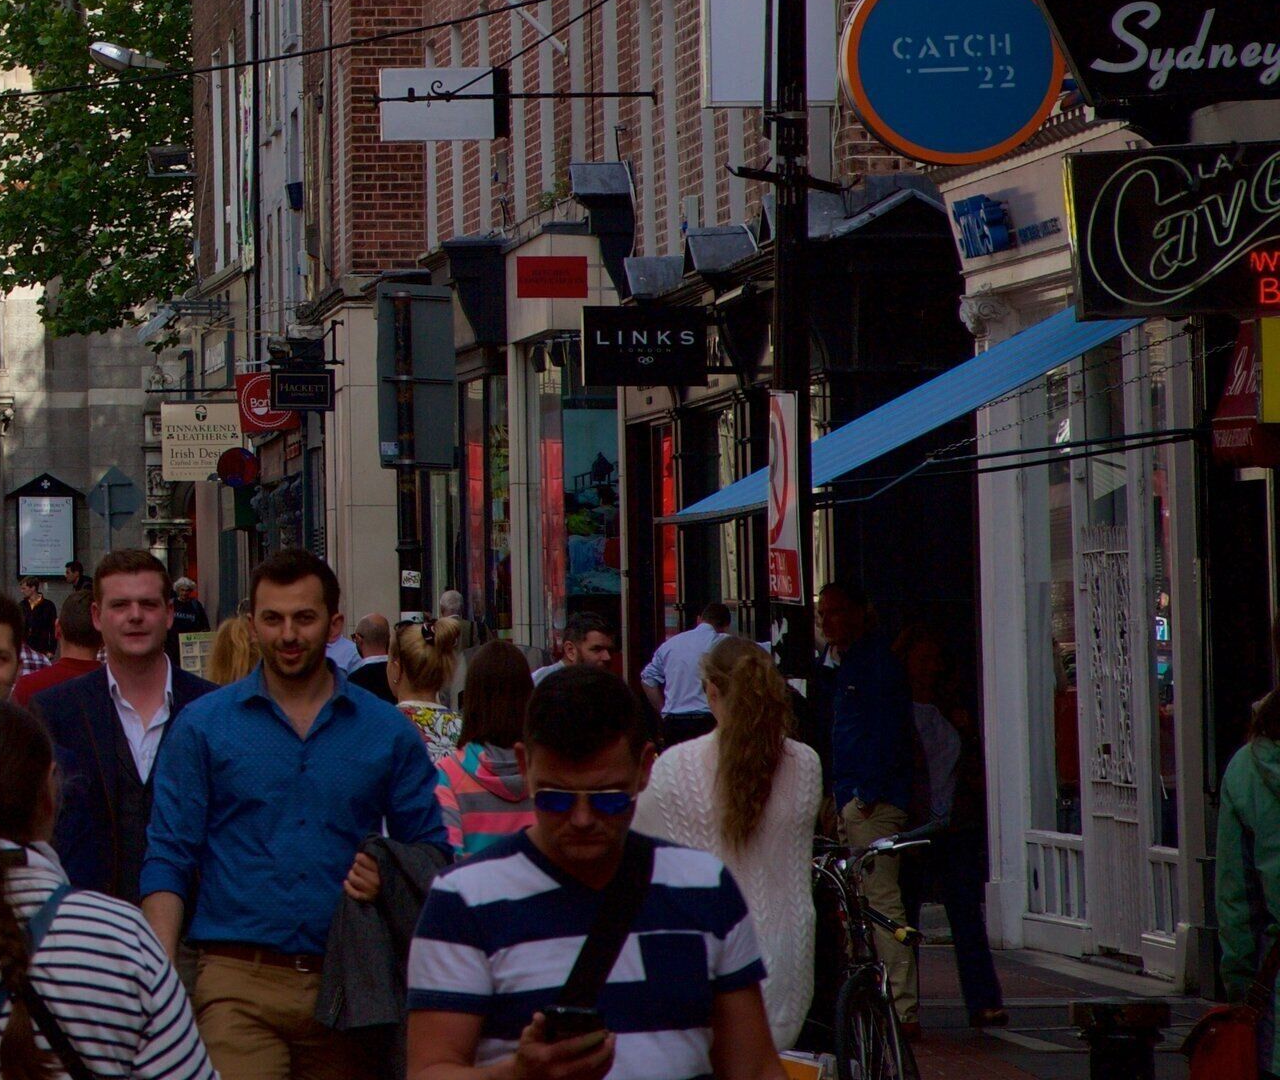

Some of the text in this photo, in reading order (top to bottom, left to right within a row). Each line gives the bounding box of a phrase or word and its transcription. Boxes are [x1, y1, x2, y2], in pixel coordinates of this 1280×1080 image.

[892, 33, 1013, 60] CATCH
[976, 65, 1016, 89] 22
[596, 330, 696, 346] LINKS
[279, 383, 326, 393] HACKETT
[166, 424, 238, 433] TINNAKEENLY
[177, 433, 228, 441] LEATHERS
[170, 447, 222, 459] Irish Desi
[770, 573, 793, 595] RKING
